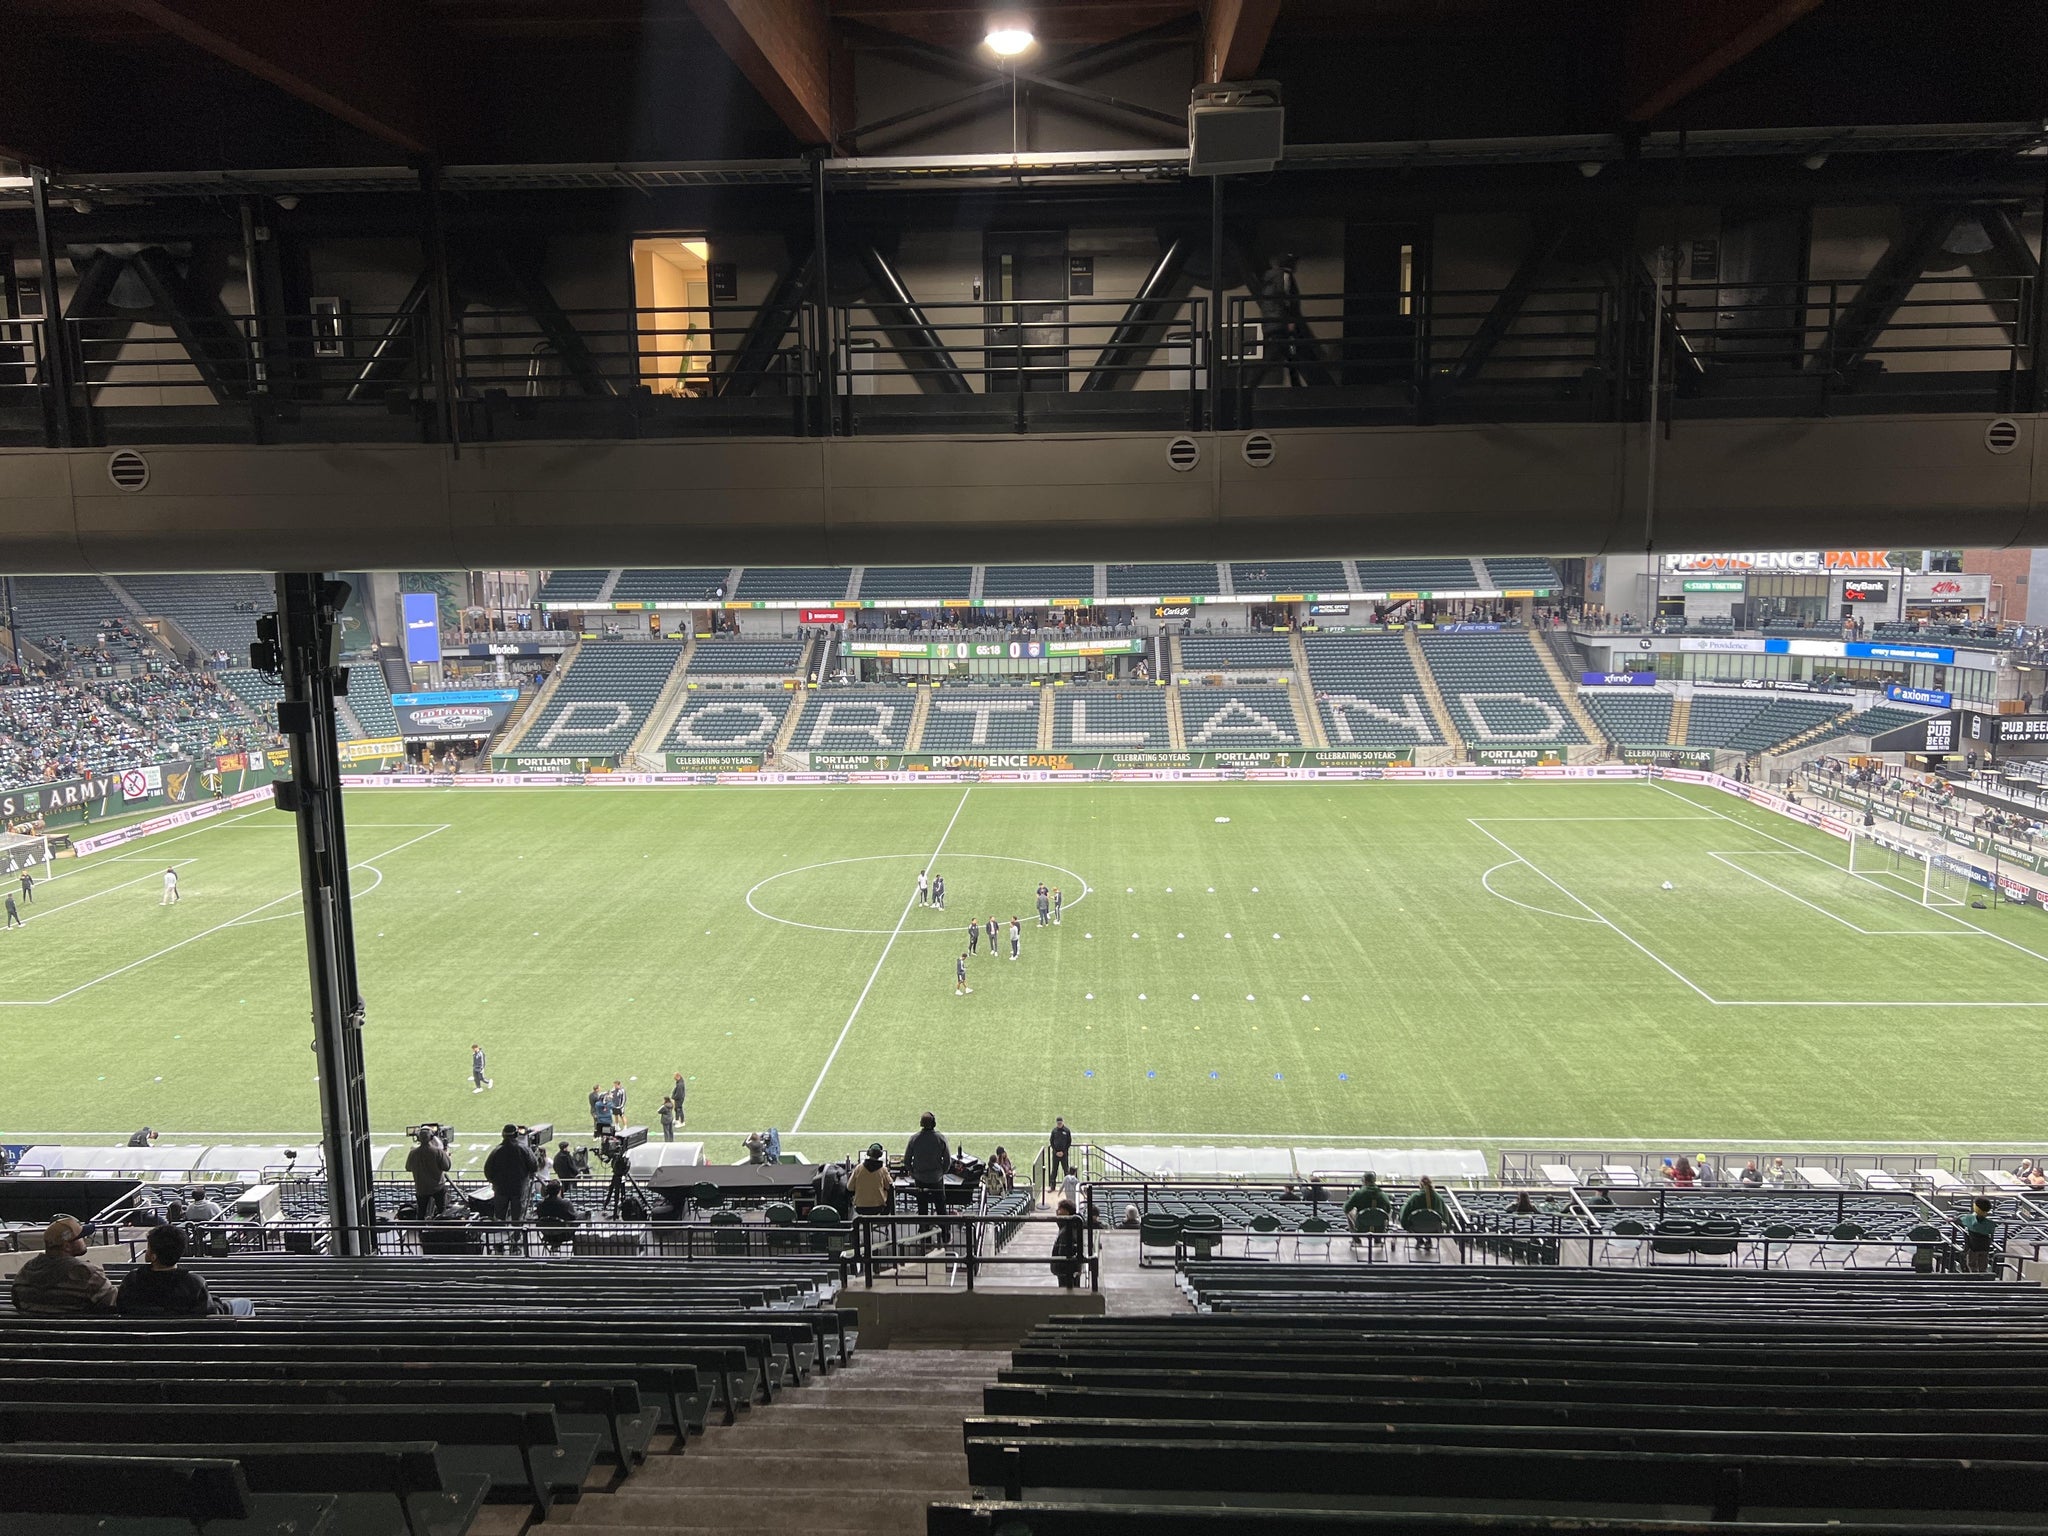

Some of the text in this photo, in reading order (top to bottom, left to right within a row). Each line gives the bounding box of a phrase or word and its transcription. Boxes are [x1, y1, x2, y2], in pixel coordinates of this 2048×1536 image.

[1665, 550, 1893, 569] PROVIDENCE PARK
[1712, 582, 1743, 591] TOGETHER
[1845, 581, 1884, 591] KeyBank
[488, 644, 519, 654] Modelo
[976, 645, 1001, 655] 65:18
[1009, 642, 1021, 658] 0
[1709, 641, 1748, 649] Providence
[957, 643, 968, 658] 0
[512, 662, 541, 672] Modelo
[1604, 674, 1633, 684] xfinity
[1742, 679, 1763, 688] Ford
[1902, 689, 1930, 702] axiom
[412, 708, 492, 719] OLD TRAPPER
[1928, 726, 1951, 736] PUB
[2001, 721, 2024, 733] PUB
[1926, 736, 1950, 746] BEER
[1112, 754, 1157, 762] CELEBRATING
[1168, 753, 1191, 761] YEARS
[1215, 753, 1271, 761] PORTLAND
[1316, 752, 1362, 760] CELEBRATING
[1373, 751, 1397, 759] YEARS
[1481, 750, 1539, 759] PORTLAND
[1624, 750, 1672, 758] CELEBRATING
[1686, 751, 1711, 760] YEARS
[517, 758, 571, 766] PORTLAND
[675, 757, 720, 765] CELEBRATING
[721, 757, 731, 765] 50
[815, 756, 869, 764] PORTLAND
[50, 779, 109, 807] ARMY
[1950, 828, 1976, 842] PORTLAND
[1999, 877, 2031, 896] DISCOUNT
